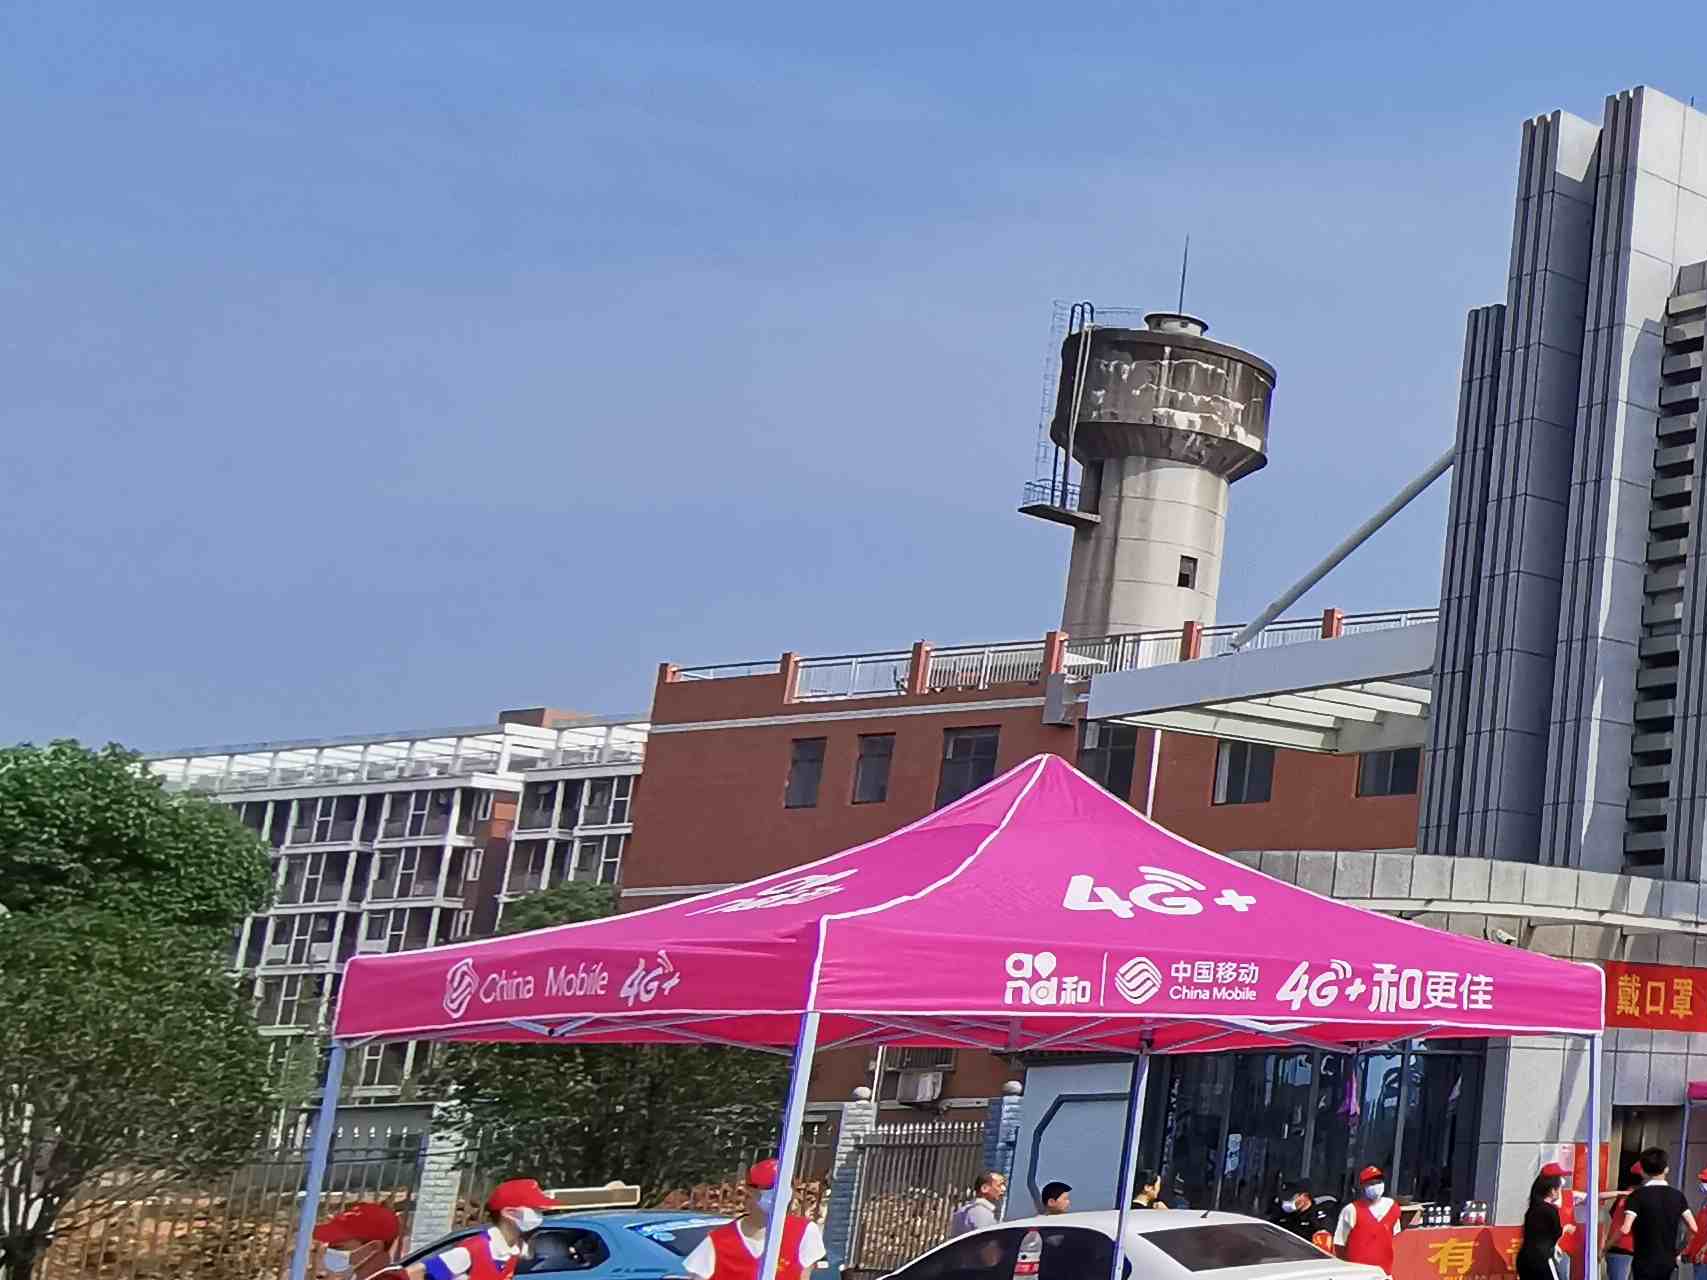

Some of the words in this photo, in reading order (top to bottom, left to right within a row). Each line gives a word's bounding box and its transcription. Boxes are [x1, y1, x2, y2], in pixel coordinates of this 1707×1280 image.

[1063, 866, 1256, 919] 4G+
[480, 971, 534, 1004] China
[545, 962, 609, 999] Mobile
[620, 951, 680, 1007] 4G+
[1169, 986, 1210, 1000] China
[1212, 986, 1257, 1001] Mobile
[1170, 960, 1259, 984] 中国移动
[1616, 974, 1694, 1020] 戴口罩
